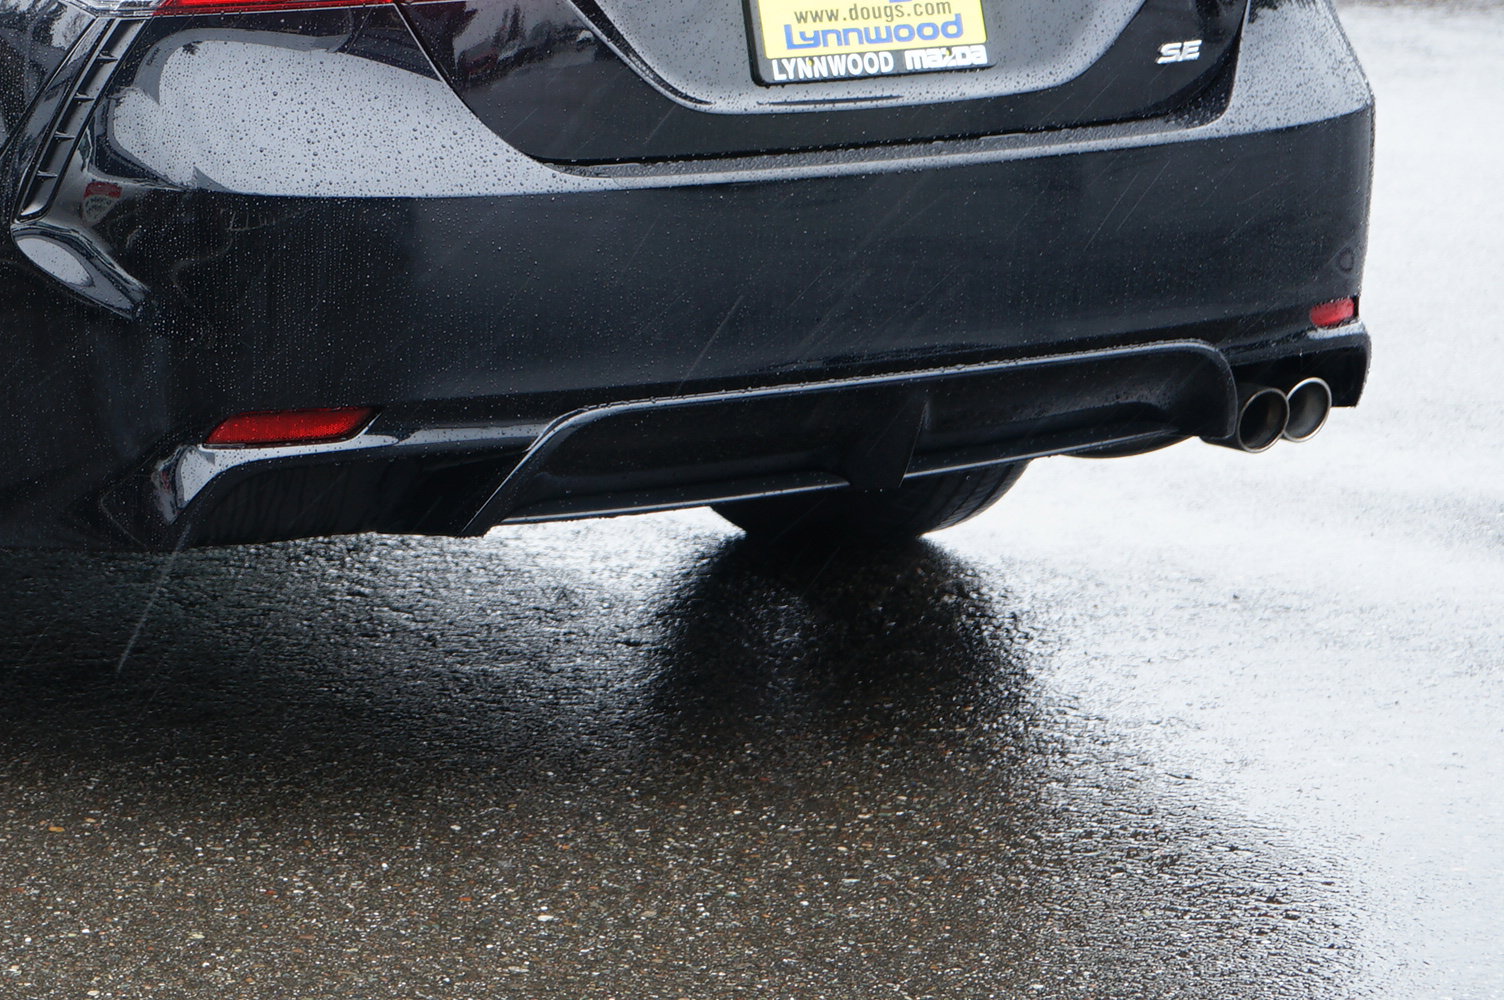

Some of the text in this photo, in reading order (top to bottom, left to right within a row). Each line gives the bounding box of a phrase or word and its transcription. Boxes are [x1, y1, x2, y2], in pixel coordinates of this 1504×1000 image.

[794, 1, 952, 24] www.dougs.com
[784, 13, 964, 50] Lynnwood
[1157, 39, 1203, 64] SE
[771, 51, 894, 81] LYNNWOOD
